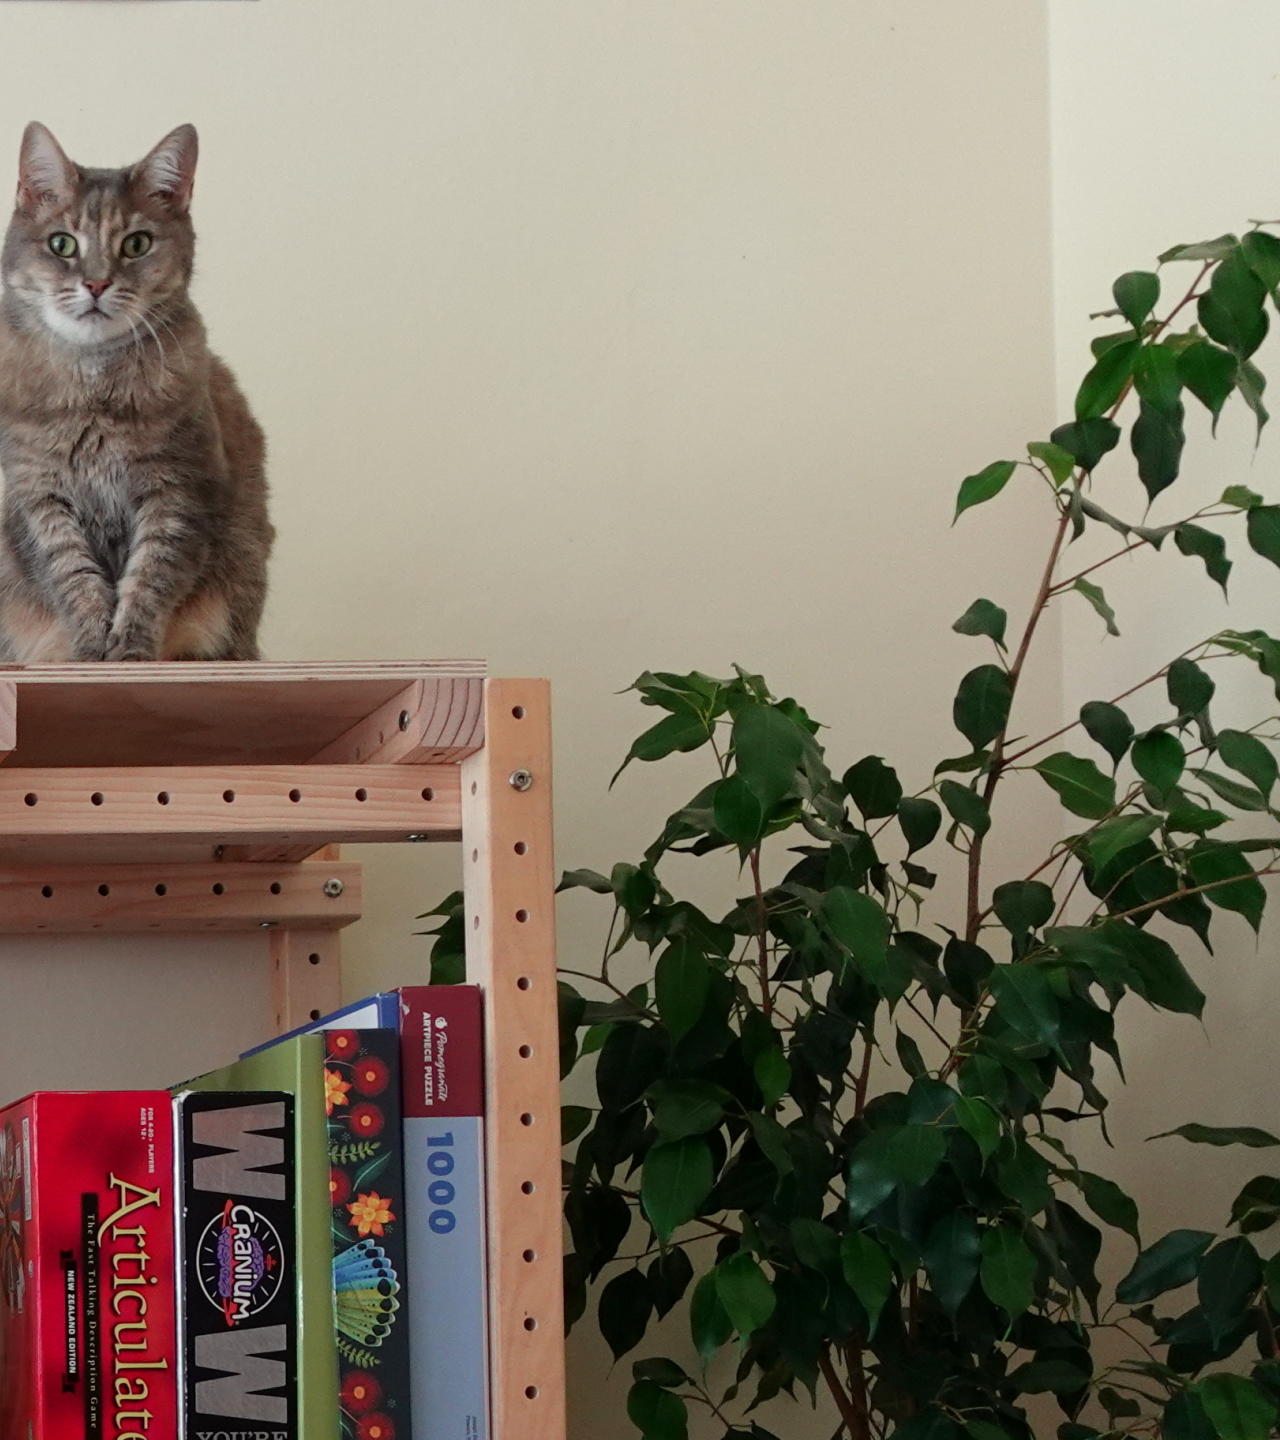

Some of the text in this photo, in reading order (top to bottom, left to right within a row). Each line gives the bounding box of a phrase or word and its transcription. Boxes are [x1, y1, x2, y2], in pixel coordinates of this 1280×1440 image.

[423, 1011, 432, 1105] ARTPIECE PUZZLE
[426, 1132, 456, 1234] 1000
[67, 1270, 76, 1373] NEW ZEALAND EDITION
